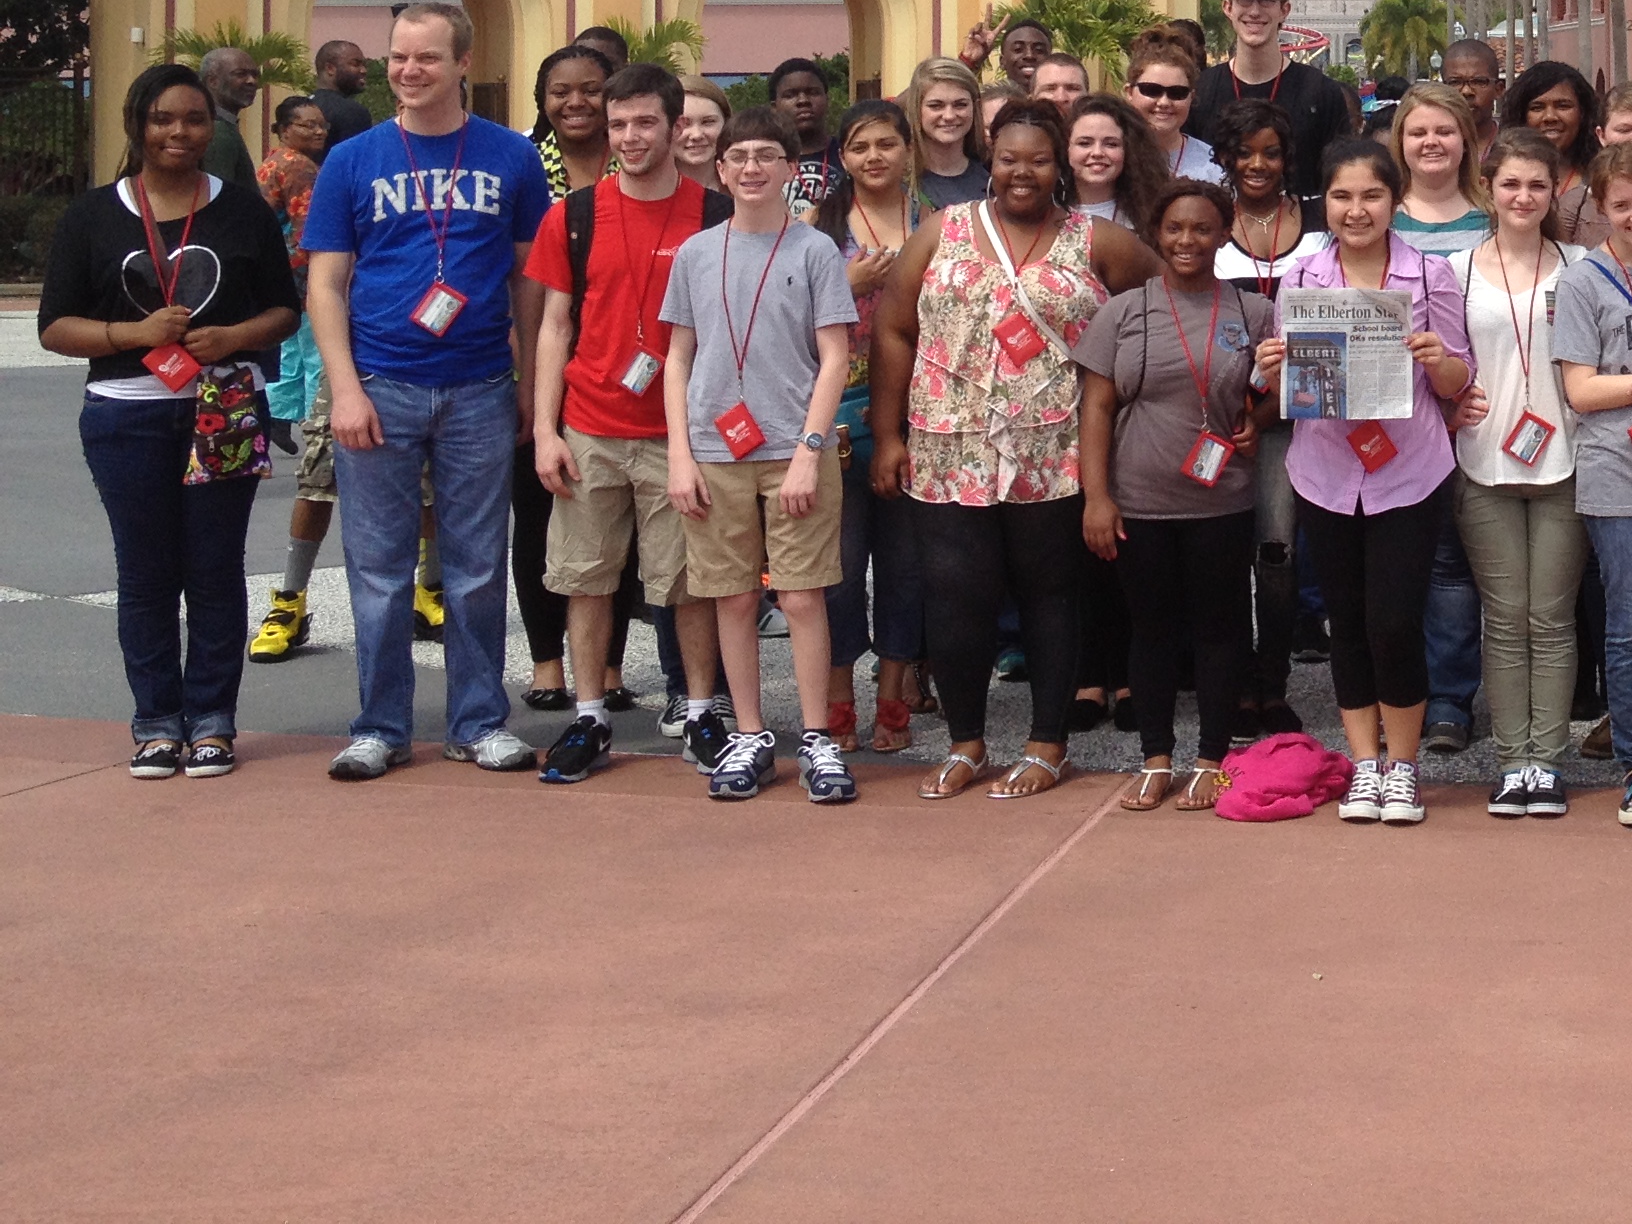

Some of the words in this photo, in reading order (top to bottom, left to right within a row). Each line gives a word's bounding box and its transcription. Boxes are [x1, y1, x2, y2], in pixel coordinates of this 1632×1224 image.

[371, 168, 501, 223] NIKE
[1290, 305, 1315, 319] The
[1318, 304, 1371, 319] Elberton
[1374, 304, 1399, 320] Star
[1352, 325, 1379, 333] School
[1381, 324, 1403, 332] board
[1291, 347, 1336, 358] ELBERT
